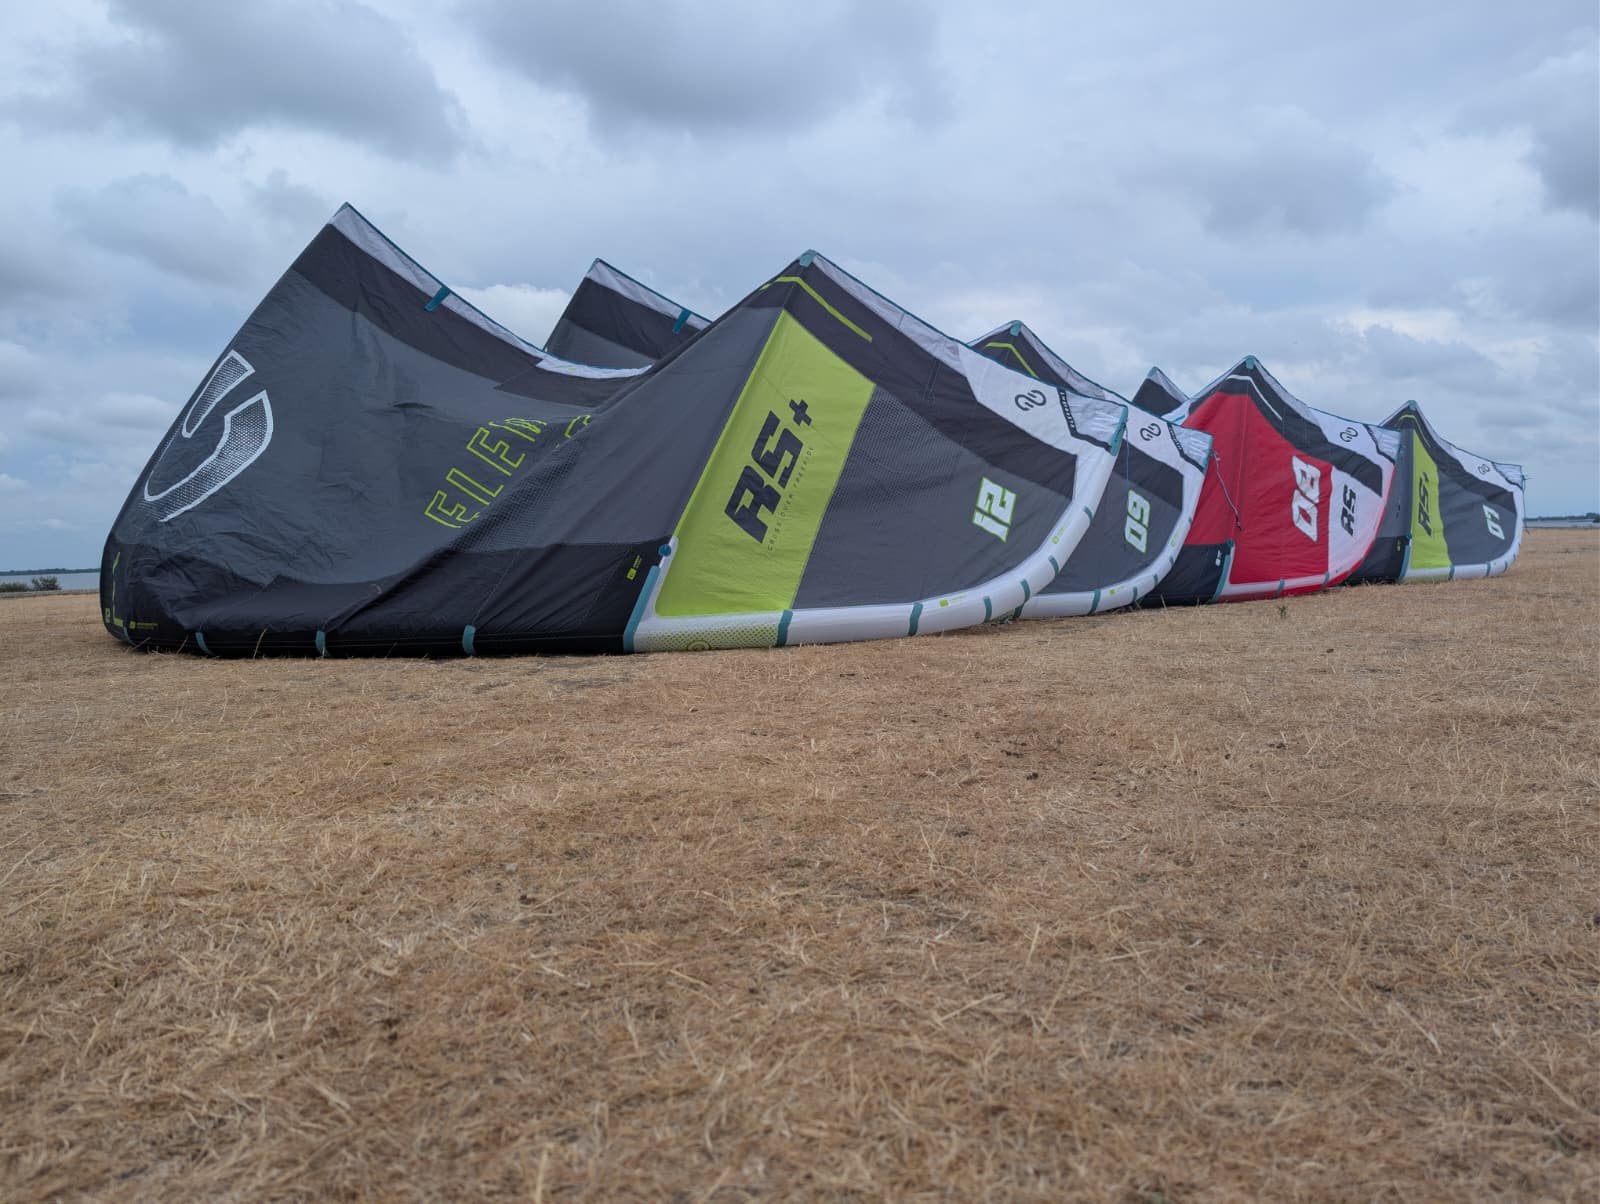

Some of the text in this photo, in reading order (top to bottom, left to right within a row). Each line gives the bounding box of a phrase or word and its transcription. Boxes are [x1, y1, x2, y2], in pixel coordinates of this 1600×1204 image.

[972, 477, 1017, 543] 12
[1124, 490, 1151, 553] 09
[1292, 454, 1321, 543] 08
[1340, 484, 1357, 537] RS
